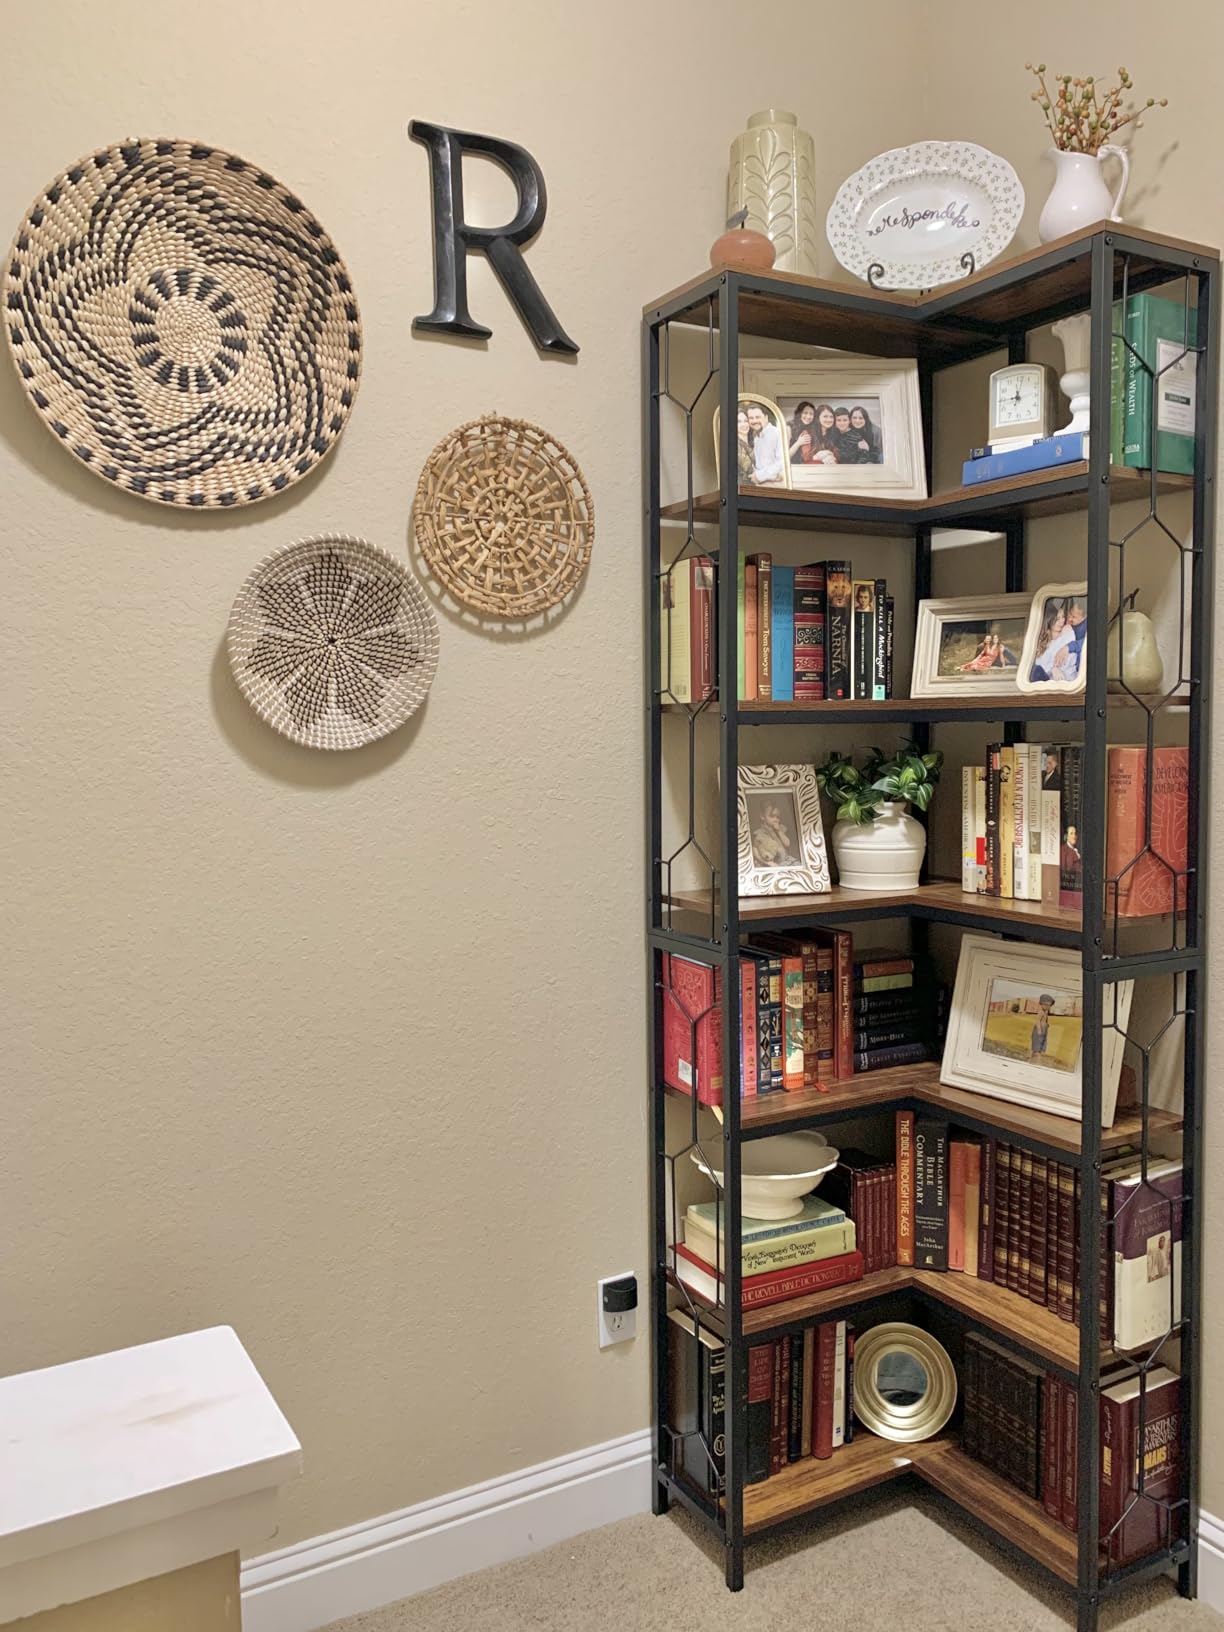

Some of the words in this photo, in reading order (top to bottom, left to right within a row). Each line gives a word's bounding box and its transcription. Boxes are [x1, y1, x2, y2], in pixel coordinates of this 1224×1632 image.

[408, 120, 580, 355] R
[1128, 379, 1137, 416] WEALTH
[831, 615, 841, 675] NARNIA
[875, 634, 885, 678] Mockingbird
[1014, 762, 1024, 791] LINCOLN
[1014, 792, 1024, 801] AT
[1072, 783, 1080, 811] FIRST
[1014, 802, 1024, 849] GETTYSBURG
[1030, 799, 1038, 828] HISTORY
[869, 1032, 905, 1044] MOBY-DICK
[901, 1119, 910, 1134] THE
[901, 1136, 909, 1157] BIBLE
[901, 1158, 909, 1199] THROUGH
[916, 1135, 925, 1206] COMMENTARY
[927, 1156, 935, 1186] BIBLE
[901, 1200, 909, 1214] THE
[900, 1215, 909, 1237] AGES
[798, 1248, 816, 1258] Words
[781, 1277, 801, 1292] BIBLE
[800, 1267, 842, 1289] DICTIONARY
